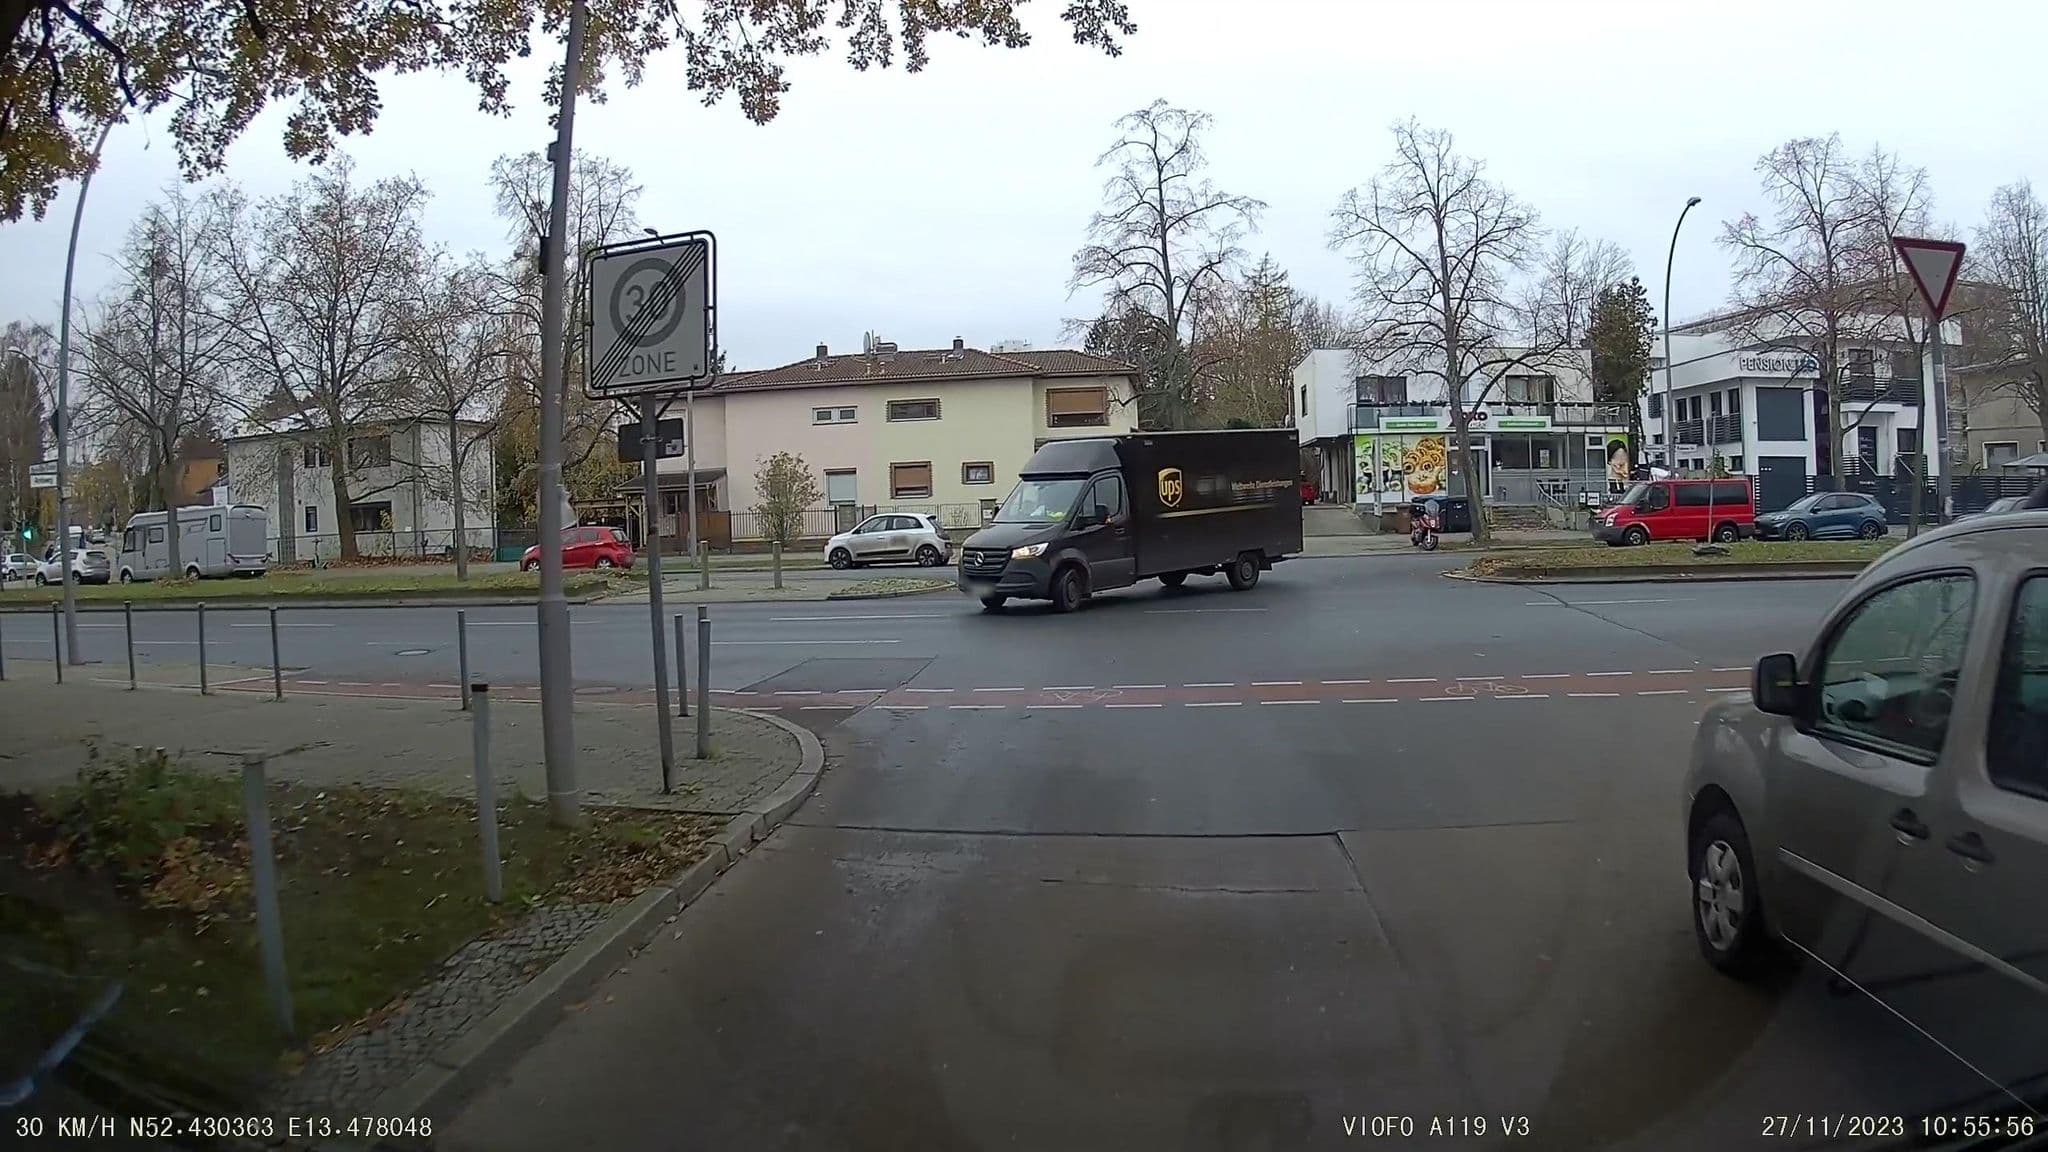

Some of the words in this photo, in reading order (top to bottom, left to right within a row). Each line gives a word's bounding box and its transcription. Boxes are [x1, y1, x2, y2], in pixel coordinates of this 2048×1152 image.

[625, 280, 671, 322] 30
[618, 351, 677, 378] ZONE
[1160, 479, 1181, 502] ups
